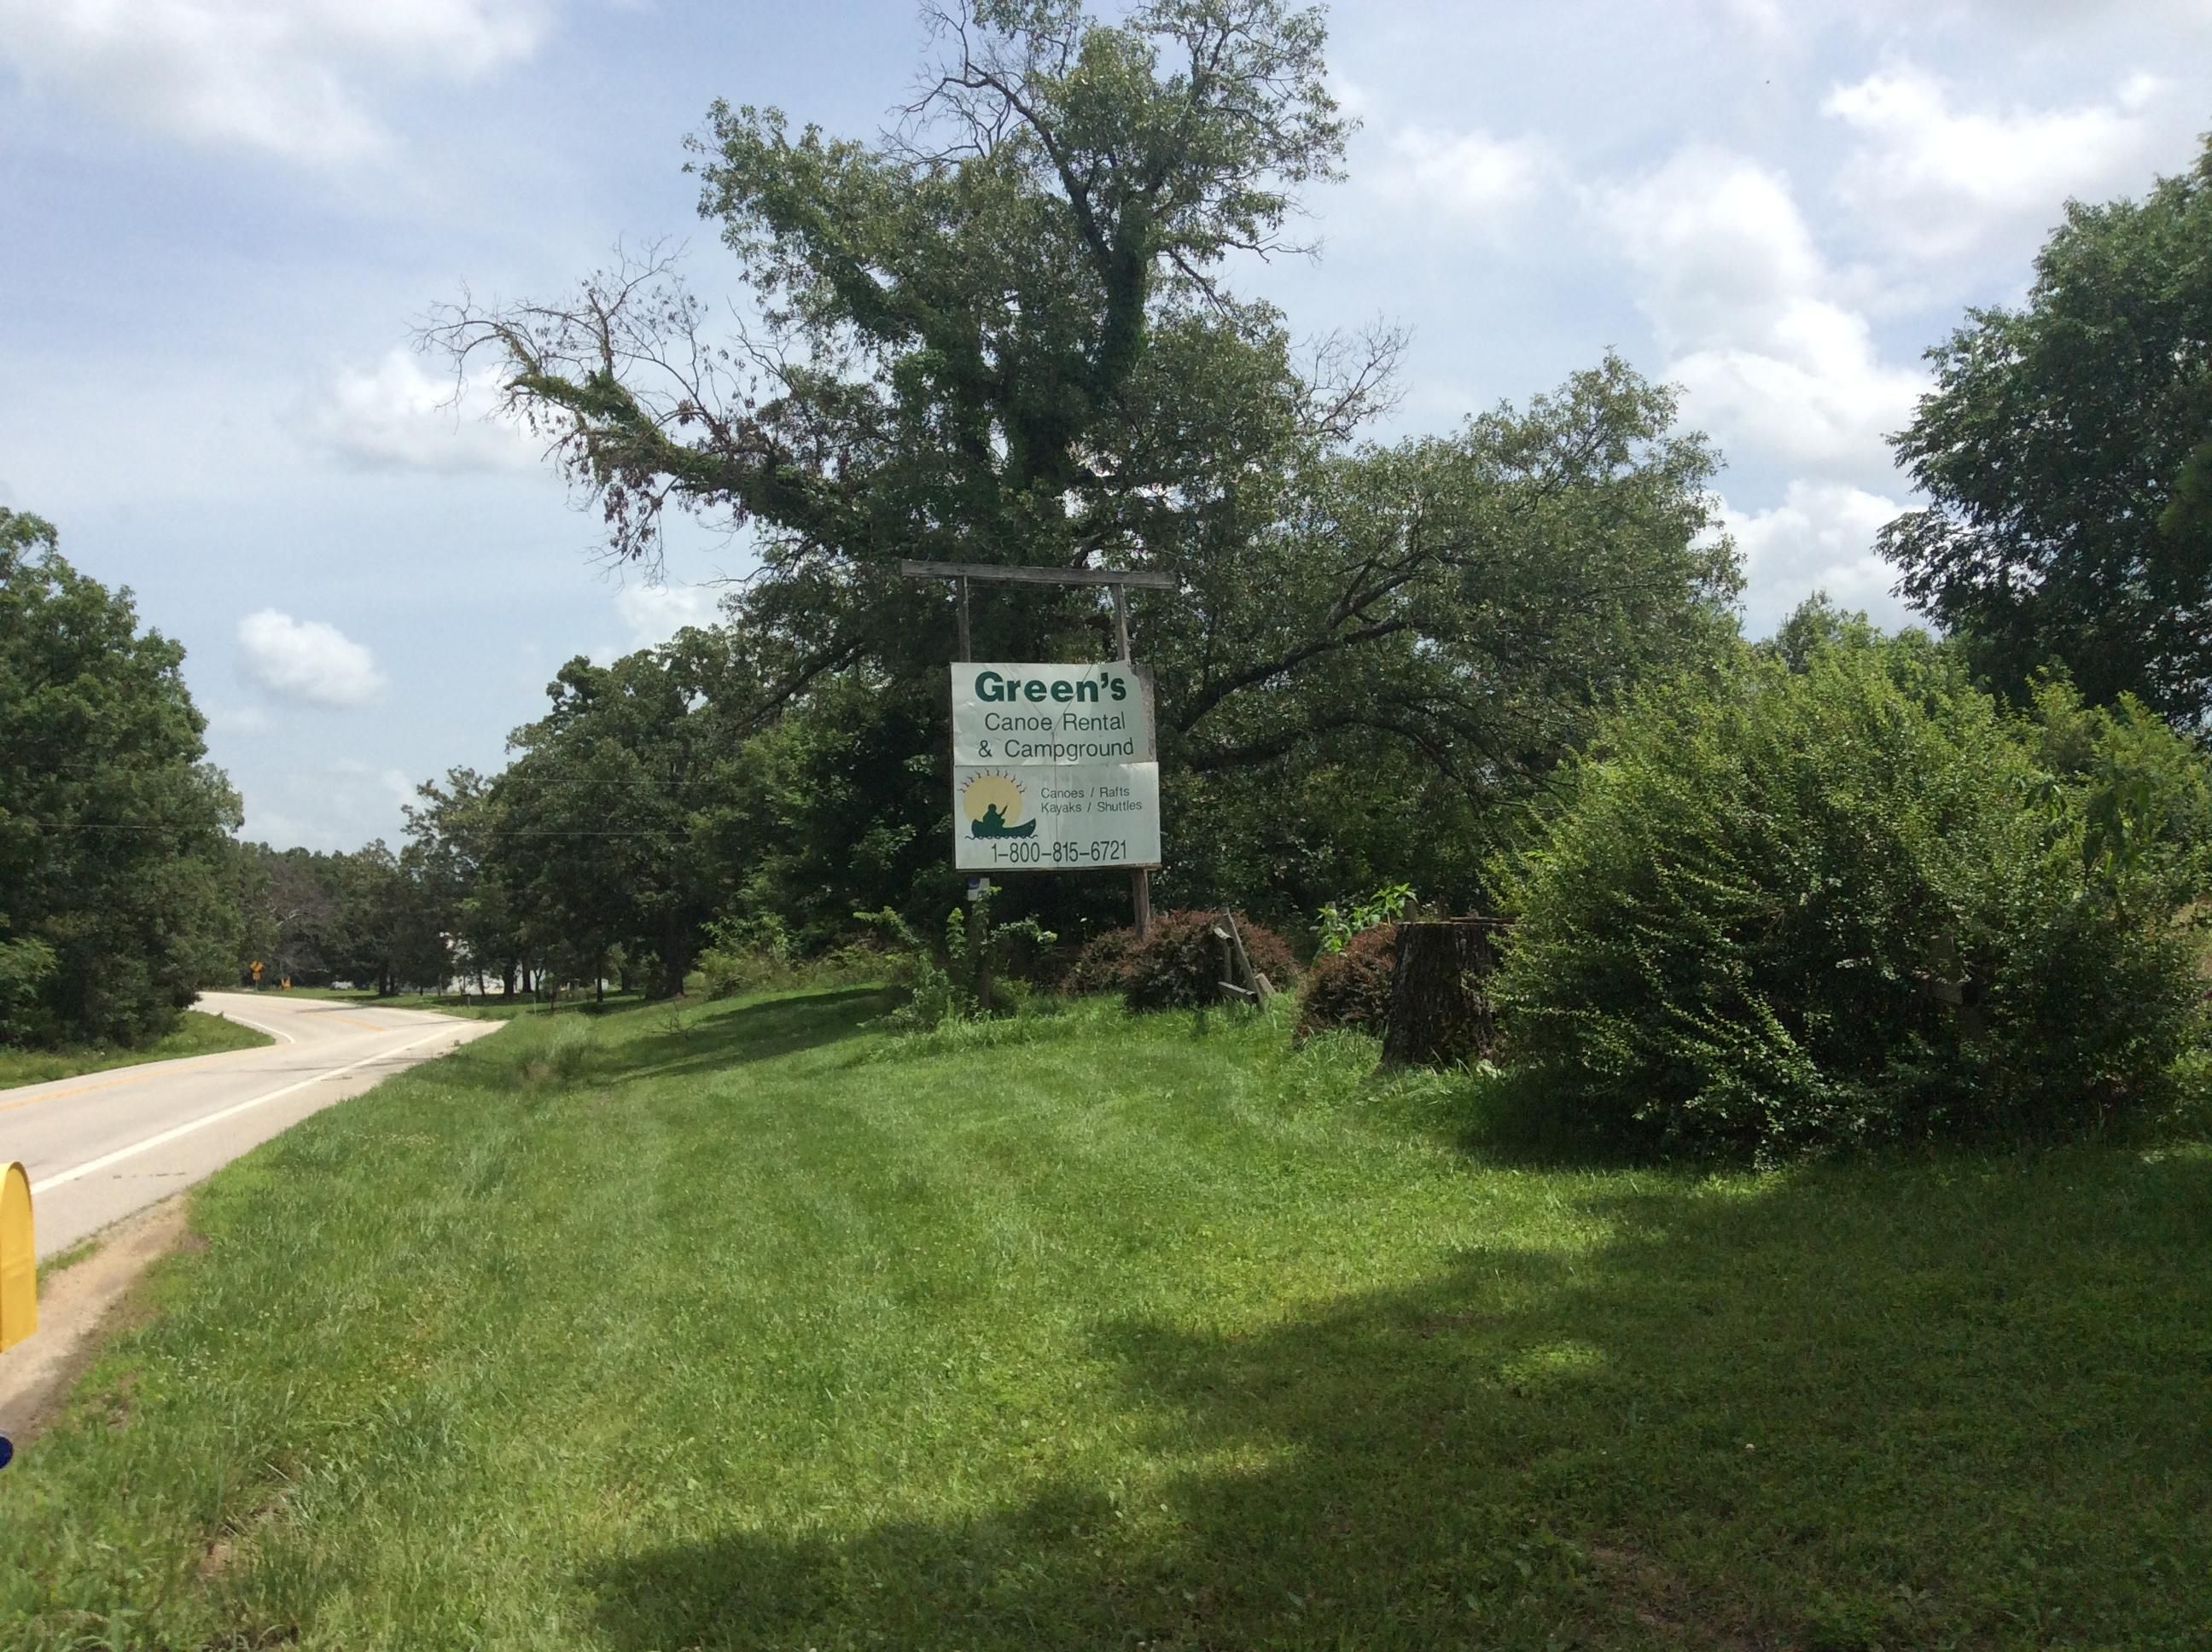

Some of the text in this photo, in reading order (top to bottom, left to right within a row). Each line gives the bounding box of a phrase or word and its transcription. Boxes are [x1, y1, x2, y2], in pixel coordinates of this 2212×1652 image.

[975, 671, 1126, 702] Green's
[985, 712, 1125, 730] Canoe Rental
[978, 737, 1133, 760] & Campground
[1040, 787, 1085, 799] Canoes
[1099, 787, 1130, 798] Rafts
[1040, 803, 1082, 814] Kayaks
[1097, 800, 1143, 812] Shuttles
[991, 840, 1127, 863] 1-800-815-6721
